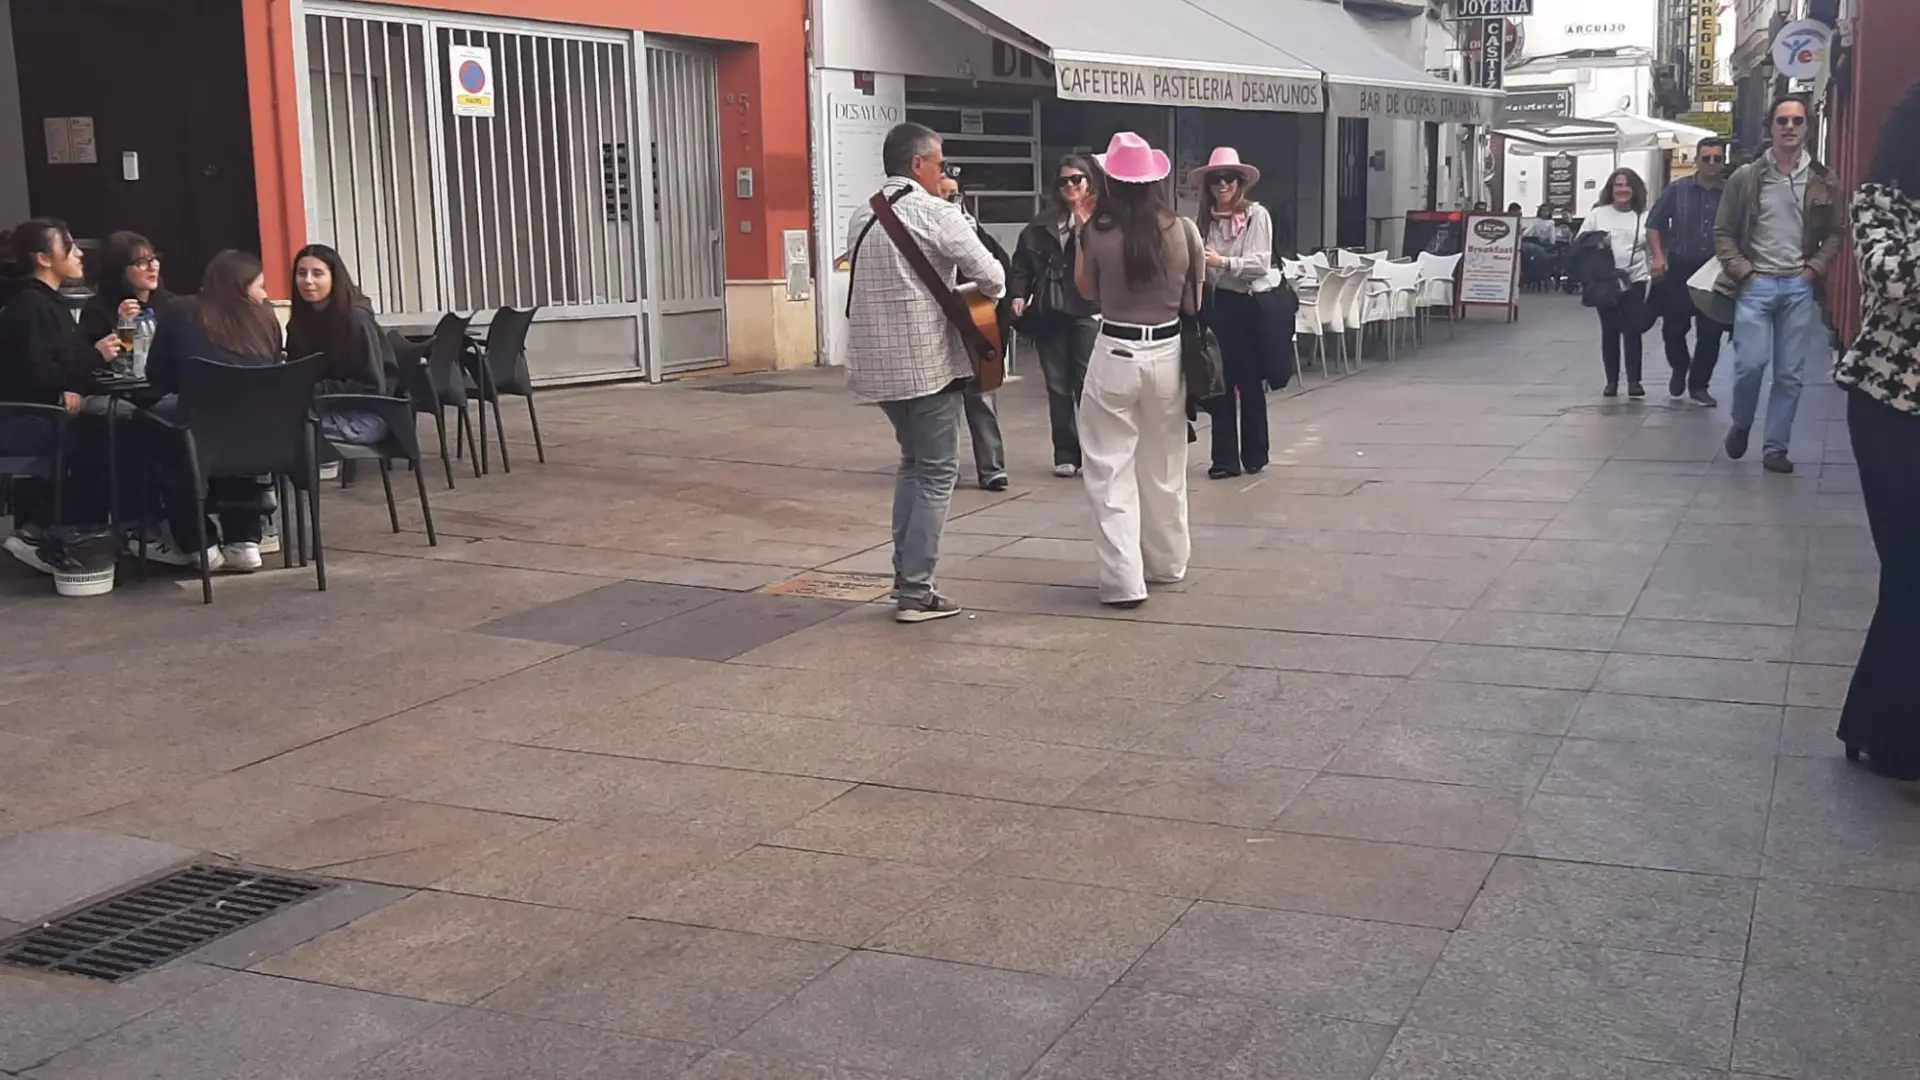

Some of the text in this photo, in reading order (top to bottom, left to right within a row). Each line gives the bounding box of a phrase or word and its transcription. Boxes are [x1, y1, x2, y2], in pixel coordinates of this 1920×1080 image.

[1460, 0, 1529, 15] JOYERIA
[1700, 0, 1713, 83] REGLOS
[1061, 67, 1318, 106] CAFETERIA PASTELERIA DESAYUNOS
[835, 103, 898, 123] DESAYUNO
[1360, 90, 1381, 113] BAR
[1386, 92, 1400, 114] DE
[1404, 93, 1436, 117] COPAS
